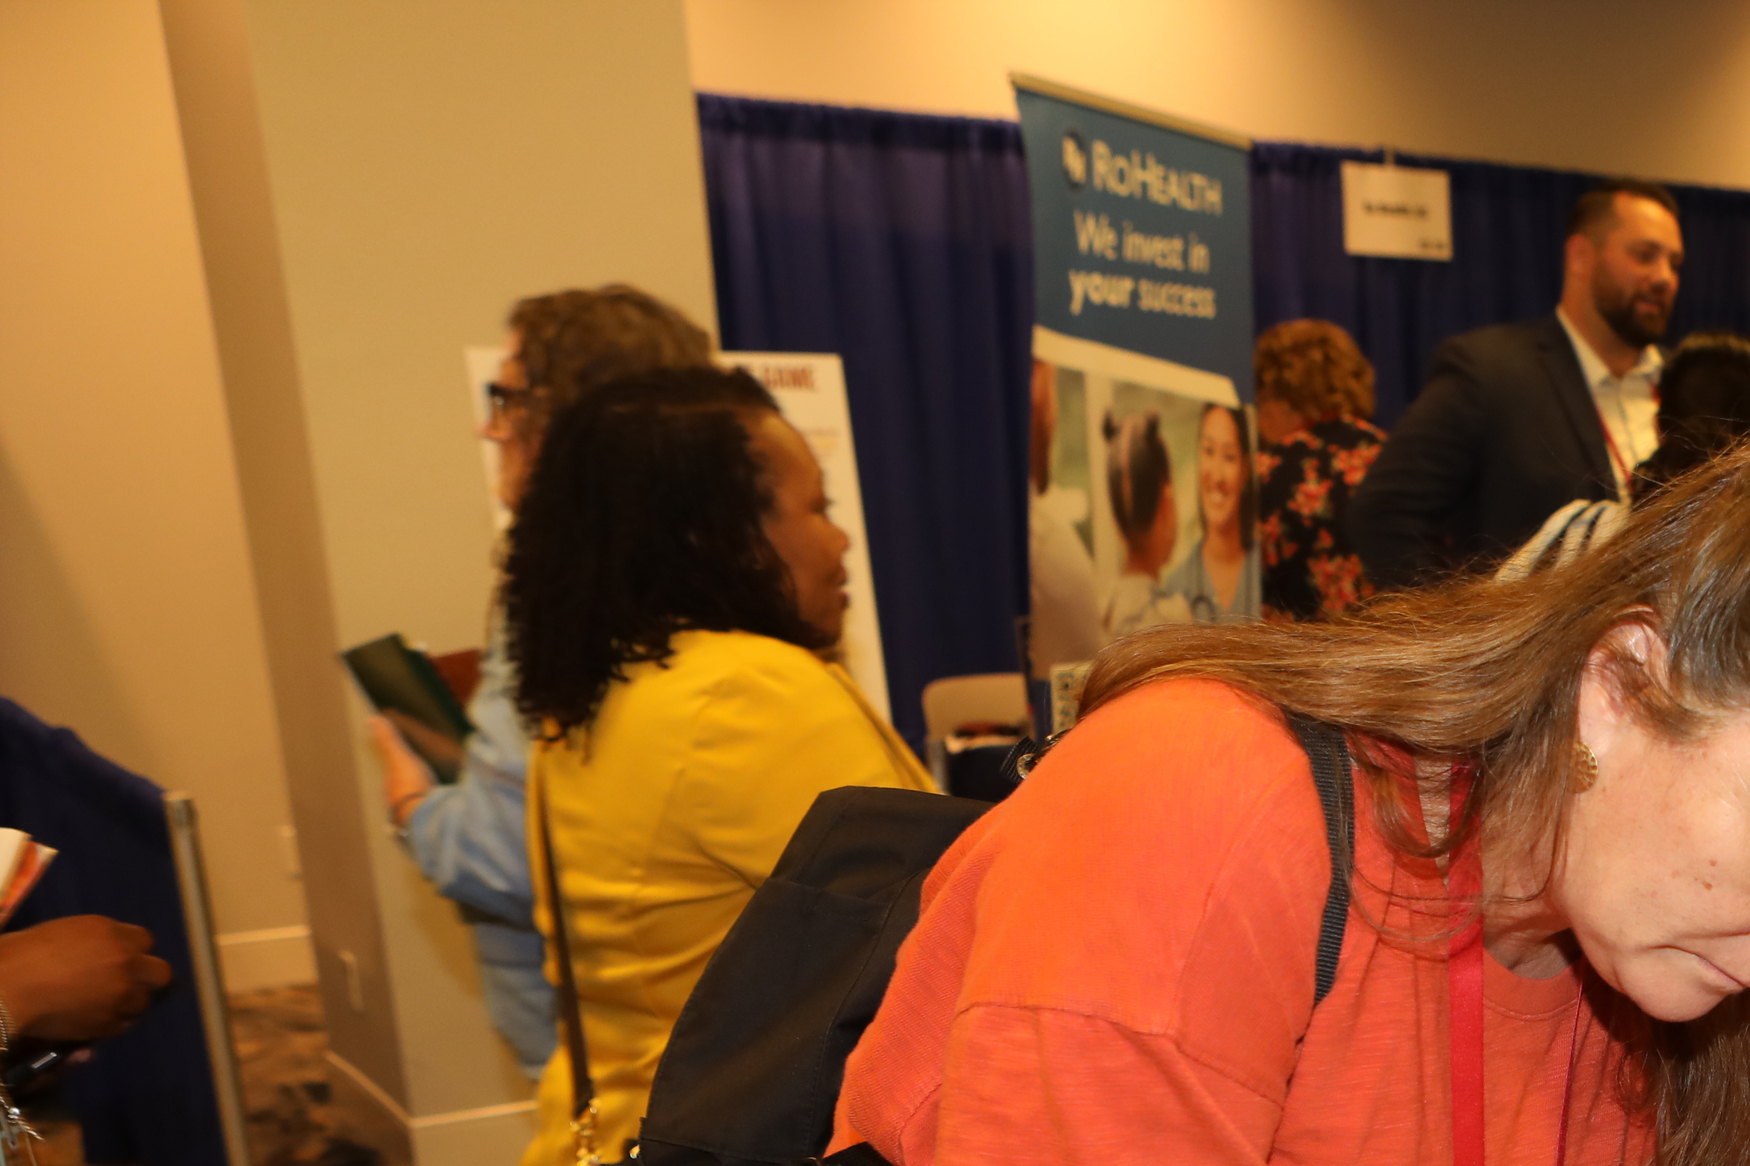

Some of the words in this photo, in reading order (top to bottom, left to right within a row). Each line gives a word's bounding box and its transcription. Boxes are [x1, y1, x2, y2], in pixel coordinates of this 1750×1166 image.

[1074, 210, 1118, 260] We
[1123, 222, 1185, 271] invest
[1190, 233, 1210, 273] in
[1069, 270, 1133, 315] your
[1138, 280, 1216, 319] success
